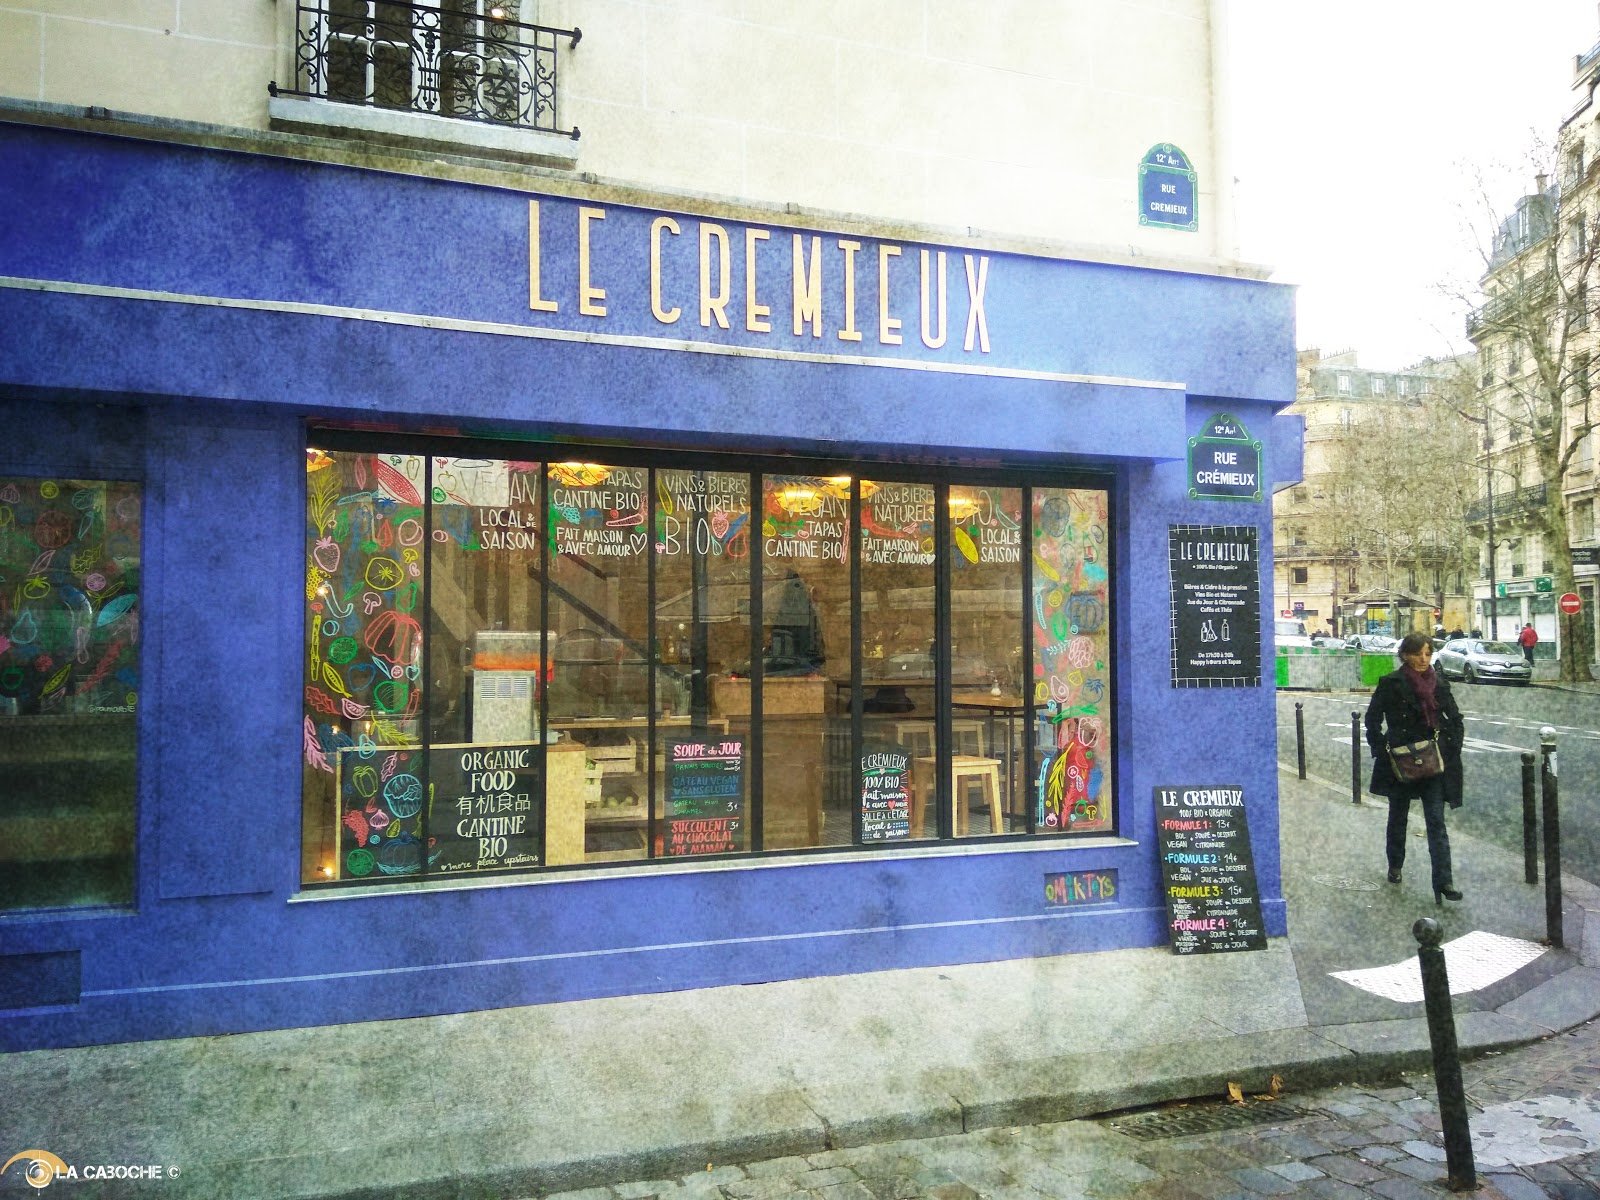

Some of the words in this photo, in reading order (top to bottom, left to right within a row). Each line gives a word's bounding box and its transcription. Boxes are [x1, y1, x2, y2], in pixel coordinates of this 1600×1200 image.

[1161, 183, 1176, 194] RUE
[1150, 201, 1188, 215] CREMIEUX
[529, 200, 607, 317] LE
[650, 216, 991, 353] CREMIEUX
[1214, 451, 1237, 465] RUE
[600, 470, 643, 490] TAPAS
[665, 474, 697, 494] VINS
[708, 476, 747, 495] BIERES
[1196, 469, 1255, 486] CRÉMIEUX
[459, 470, 537, 506] VEGAN
[867, 486, 894, 504] VINS
[901, 487, 935, 505] BIERES
[553, 489, 612, 511] CANTINE
[615, 491, 640, 511] BIO
[676, 494, 747, 514] NATURELS
[784, 487, 847, 519] VEGAN
[954, 489, 992, 526] BIO
[480, 508, 526, 529] LOCAL
[874, 504, 935, 522] NATURELS
[556, 526, 580, 541] FAIT
[582, 529, 623, 544] MAISON
[665, 515, 711, 556] BIO
[806, 520, 843, 538] TAPAS
[980, 527, 1014, 545] LOCAL
[480, 530, 535, 551] SAISON
[765, 538, 819, 559] CANTINE
[821, 541, 842, 560] BIO
[862, 537, 882, 551] FAIT
[882, 538, 919, 552] MAISON
[596, 543, 631, 557] AMOUR
[897, 552, 928, 565] AMOUR
[980, 547, 1020, 563] SAISON
[1181, 542, 1193, 560] LE
[1196, 542, 1250, 561] CREMIEUX
[673, 743, 706, 757] SOUPE
[718, 742, 742, 756] JOUR
[460, 748, 530, 772] ORGANIC
[867, 752, 908, 770] CREMIEUX
[470, 770, 516, 793] FOOD
[884, 775, 900, 789] BIO
[455, 791, 531, 816] 有机食品
[880, 791, 909, 800] maison
[1161, 790, 1178, 807] LE
[1183, 789, 1244, 807] CREMIEUX
[1193, 809, 1204, 818] BIO
[1208, 808, 1233, 818] ORGANIC
[456, 815, 526, 838] CANTINE
[671, 820, 727, 833] SUCCULENT
[864, 821, 886, 832] local
[1164, 819, 1202, 831] FORMULE
[671, 834, 684, 845] AU
[686, 830, 733, 843] CHOCOLAT
[872, 830, 881, 839] de
[478, 836, 508, 859] BIO
[675, 844, 687, 855] DE
[690, 841, 727, 854] MAMAN
[1166, 840, 1188, 848] VEGAN
[1167, 853, 1210, 864] FORMULE
[1170, 873, 1192, 881] VEGAN
[1200, 876, 1212, 884] JUS
[1218, 876, 1235, 884] JOUR
[1170, 885, 1210, 898] FORMULE
[1173, 918, 1217, 931] FORMULE
